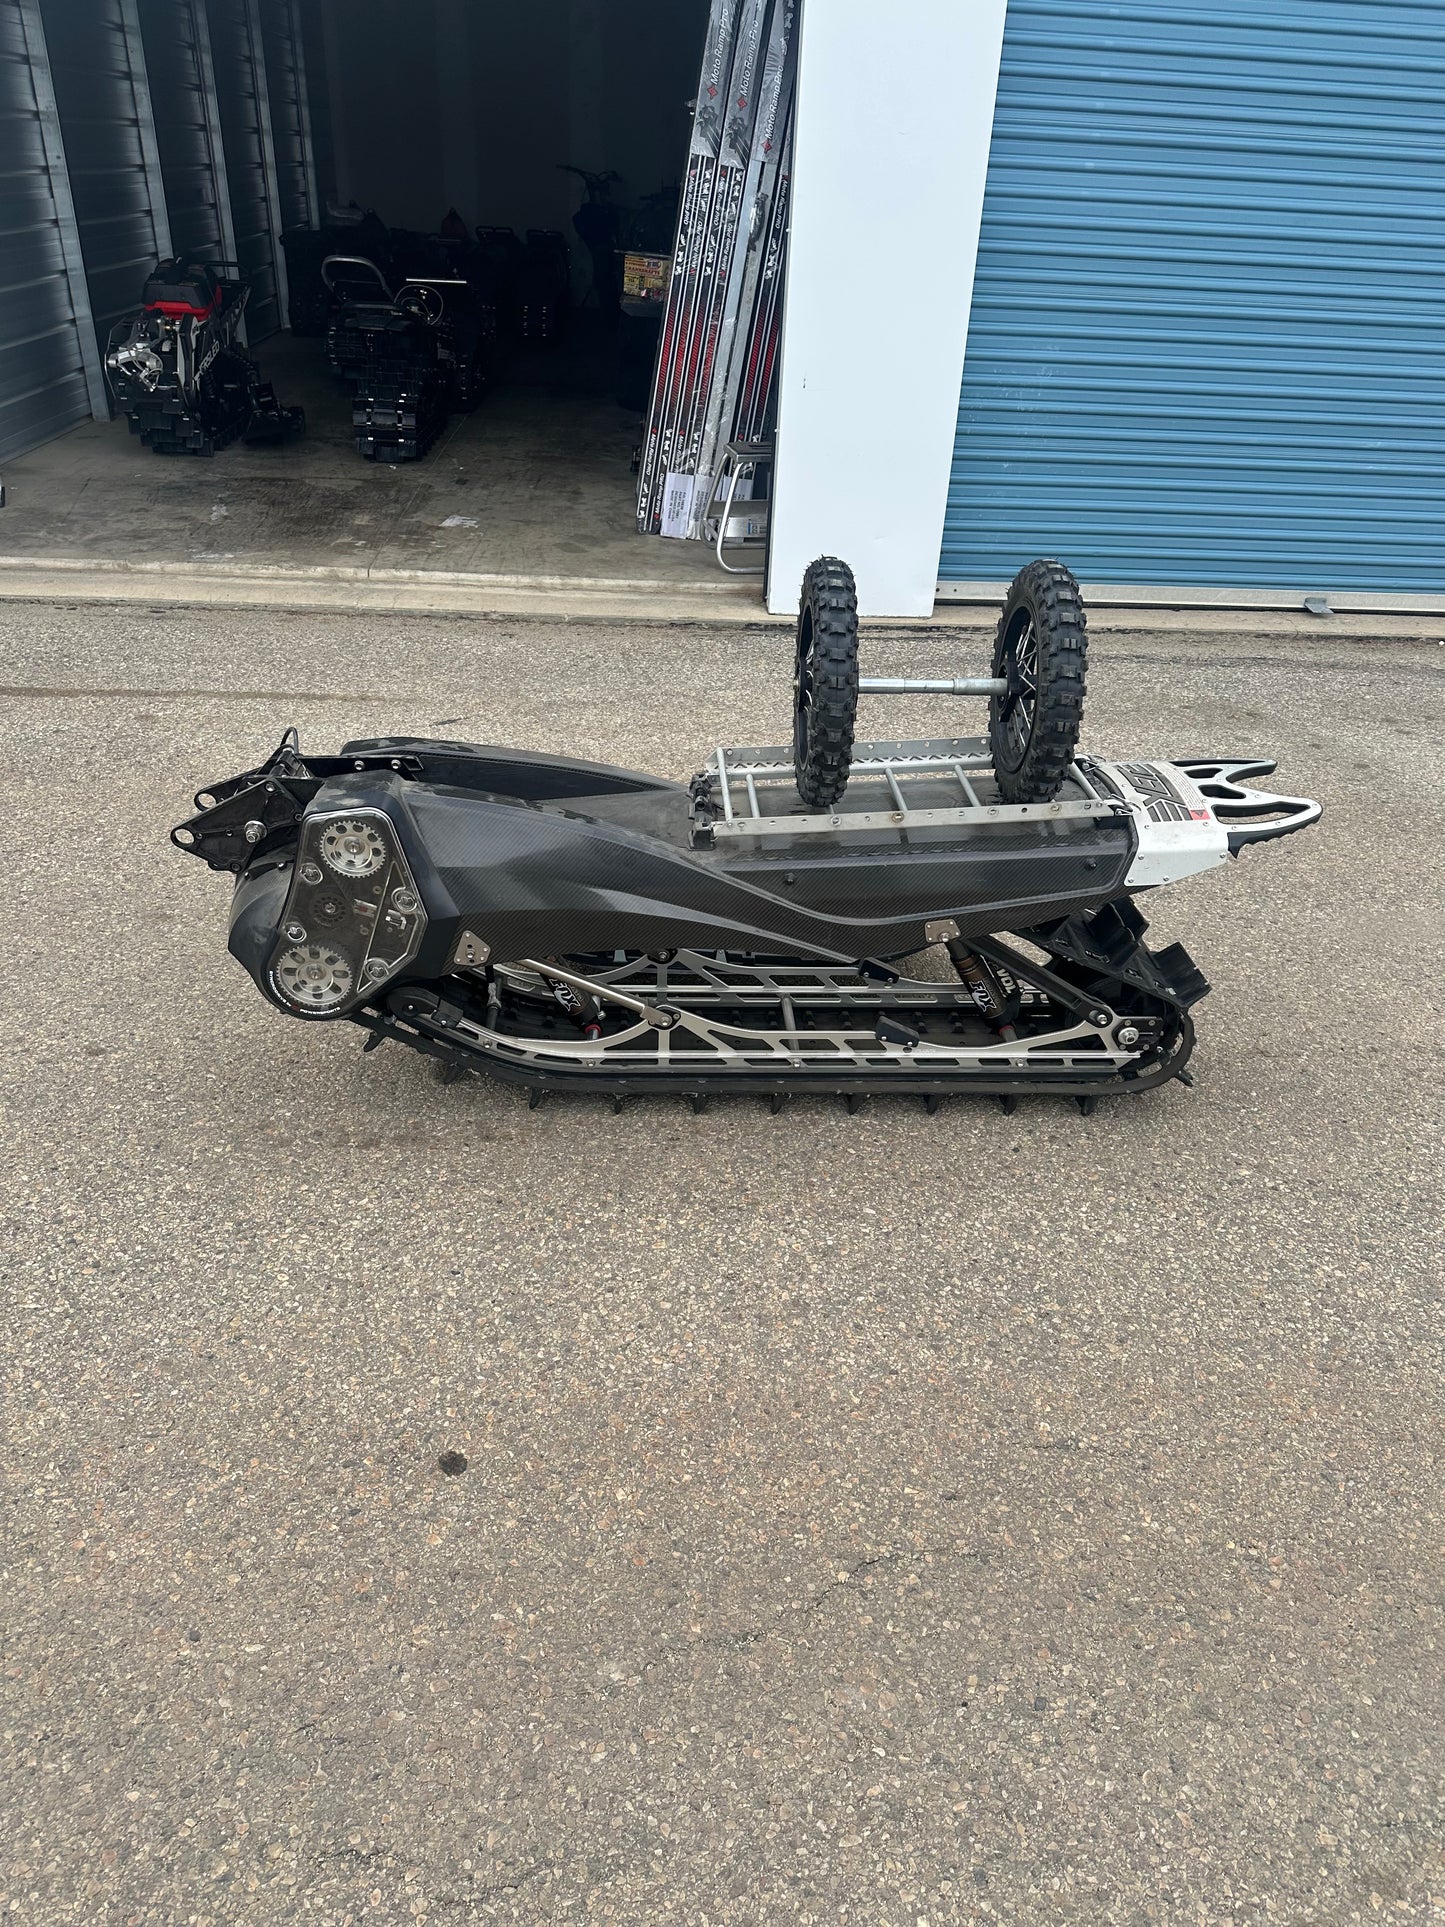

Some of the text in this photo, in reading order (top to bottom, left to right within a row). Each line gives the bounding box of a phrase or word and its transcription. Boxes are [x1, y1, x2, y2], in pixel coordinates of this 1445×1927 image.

[711, 9, 729, 84] Moto Ramp Pro
[740, 20, 759, 96] Moto Ramp Pro
[765, 65, 784, 140] Moto Ramp Pro
[1112, 764, 1187, 807] YETI
[548, 979, 581, 1012] FOX
[968, 981, 998, 1013] FOX
